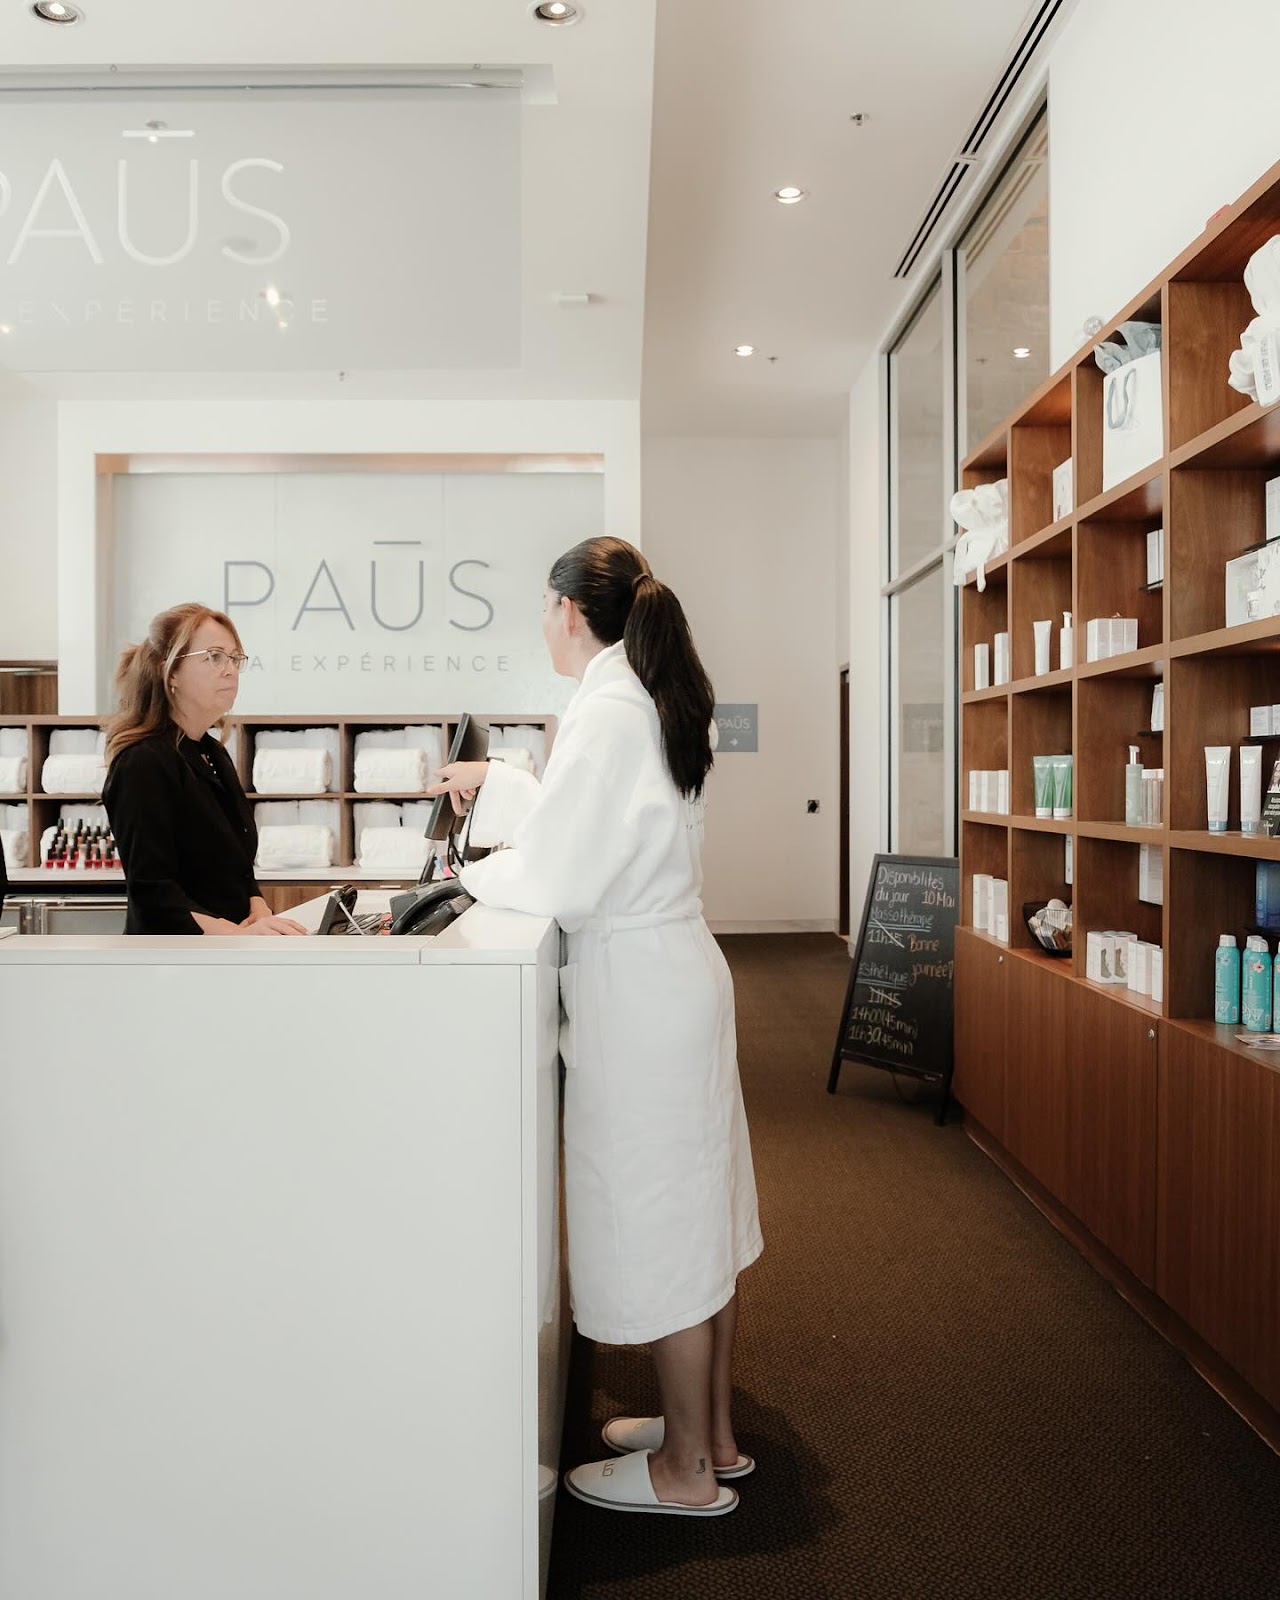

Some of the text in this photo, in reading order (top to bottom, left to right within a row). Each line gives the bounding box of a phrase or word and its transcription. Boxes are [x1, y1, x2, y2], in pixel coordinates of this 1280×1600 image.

[224, 540, 494, 632] PAŪS
[291, 651, 510, 672] EXPÉRIENCE
[875, 890, 889, 902] du
[889, 892, 910, 908] jour
[907, 935, 940, 953] Bonne
